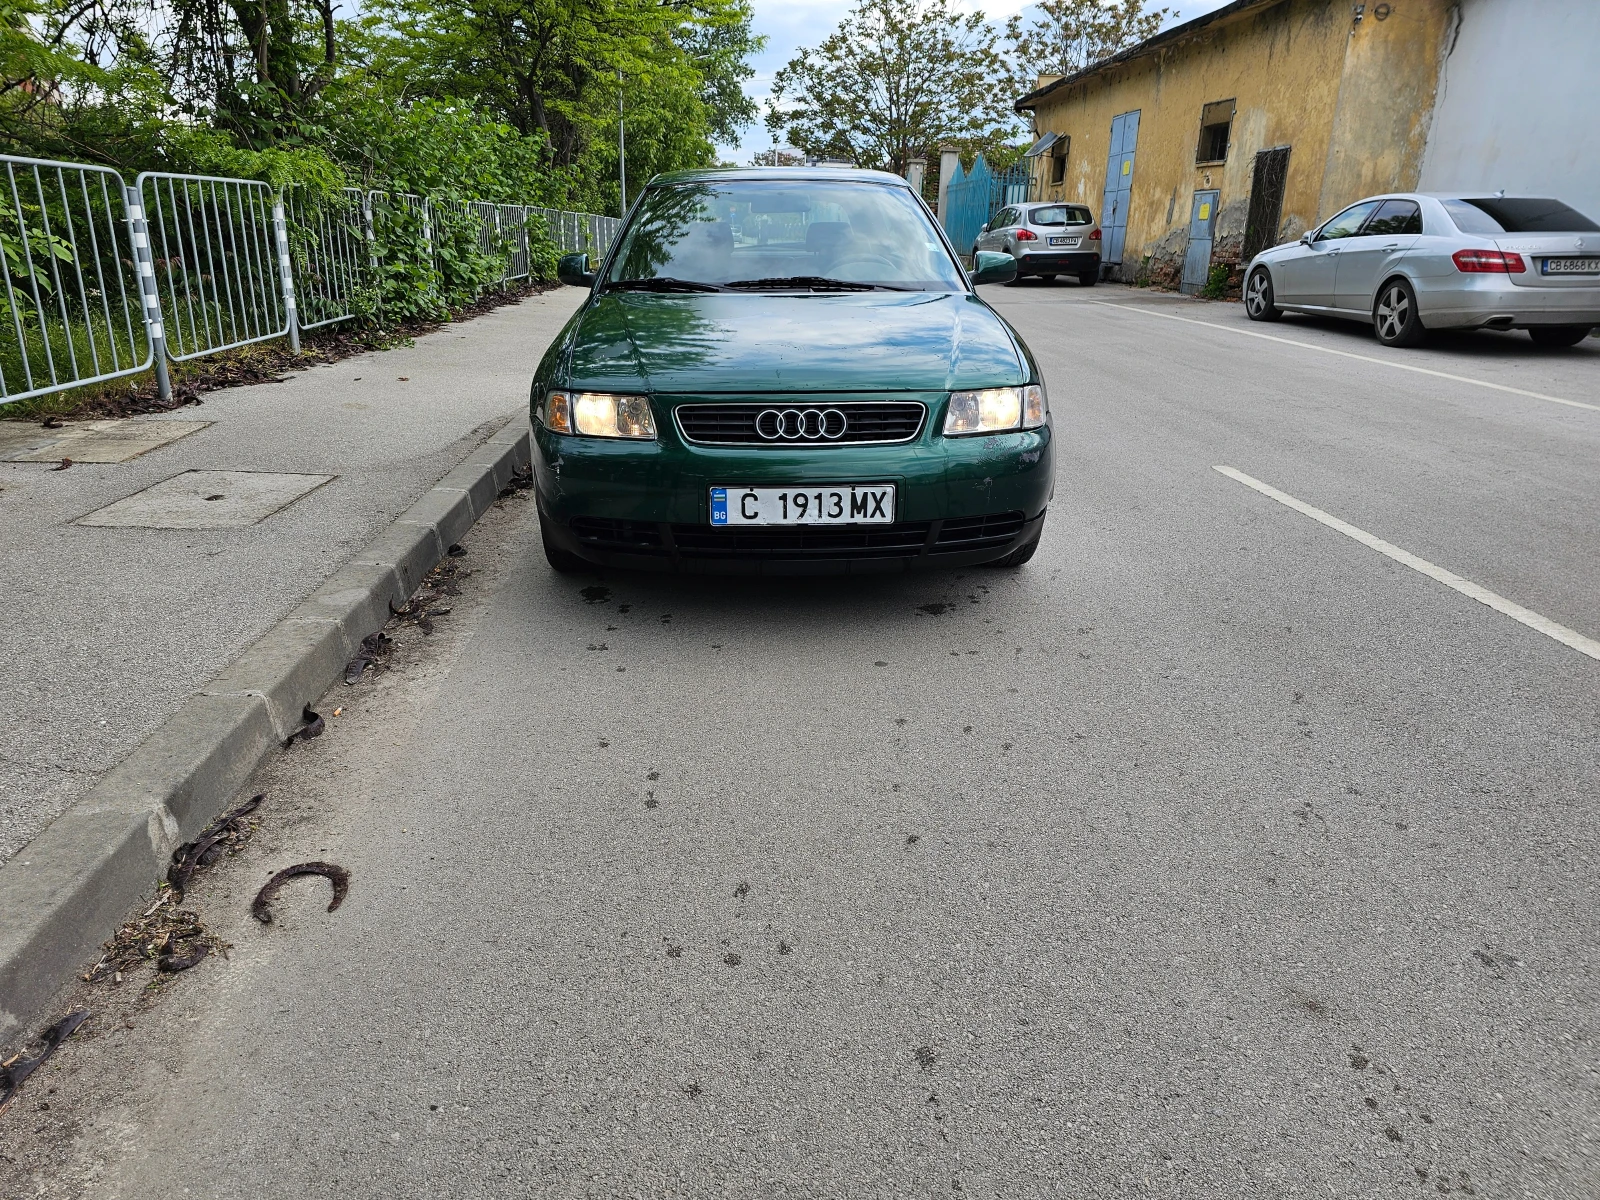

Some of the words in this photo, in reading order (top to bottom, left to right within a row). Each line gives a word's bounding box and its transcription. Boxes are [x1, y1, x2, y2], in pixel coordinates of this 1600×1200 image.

[1549, 260, 1562, 270] CB
[1563, 260, 1586, 270] 6868
[741, 492, 758, 519] C
[778, 492, 843, 519] 1913
[850, 491, 887, 519] MX
[714, 511, 726, 520] BG
